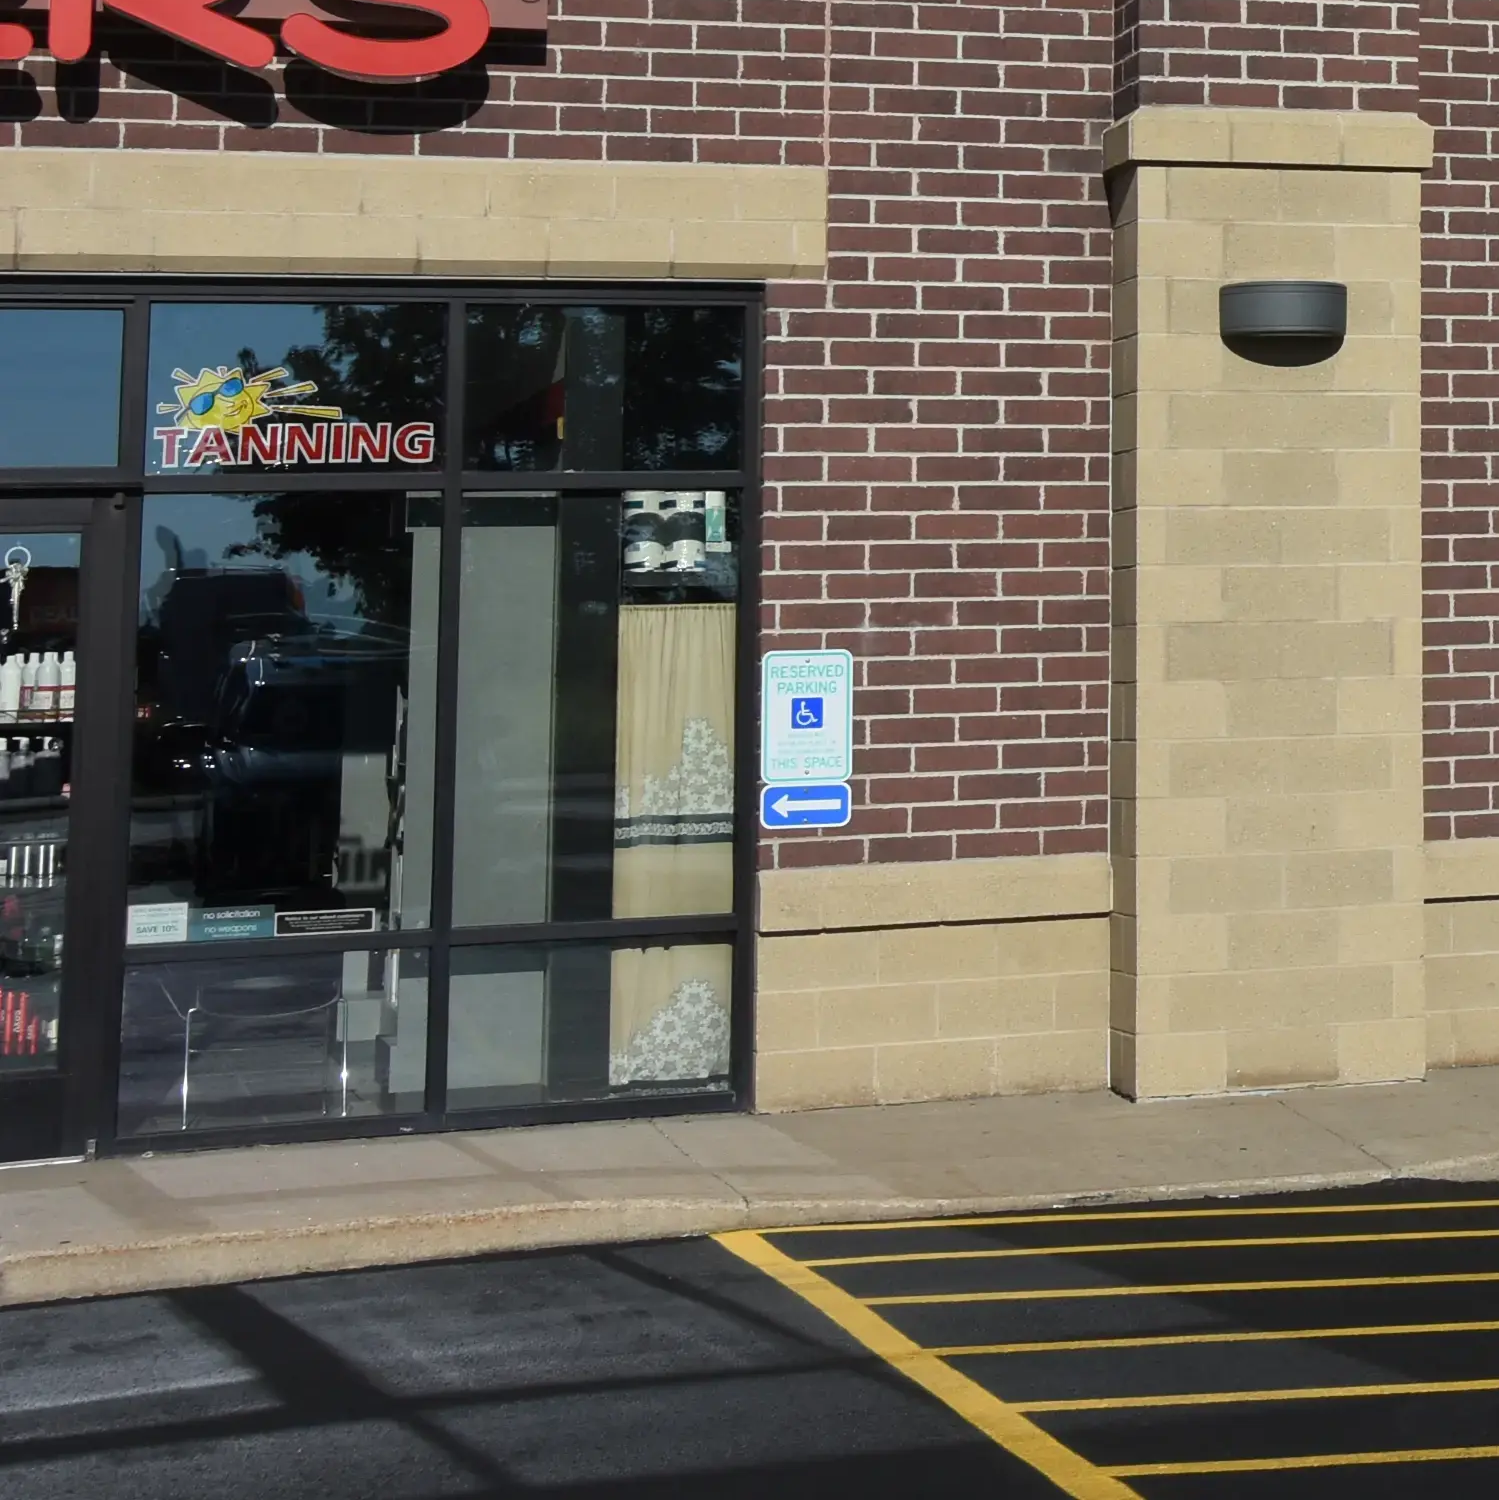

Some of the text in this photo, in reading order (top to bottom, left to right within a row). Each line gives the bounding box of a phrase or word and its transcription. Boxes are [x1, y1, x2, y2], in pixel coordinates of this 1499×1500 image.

[154, 422, 435, 468] TANNING
[770, 664, 844, 679] RESERVED
[777, 681, 837, 694] PARKING
[771, 756, 842, 770] THIS SPACE
[203, 909, 260, 920] no solicitation
[136, 925, 157, 934] SAVE
